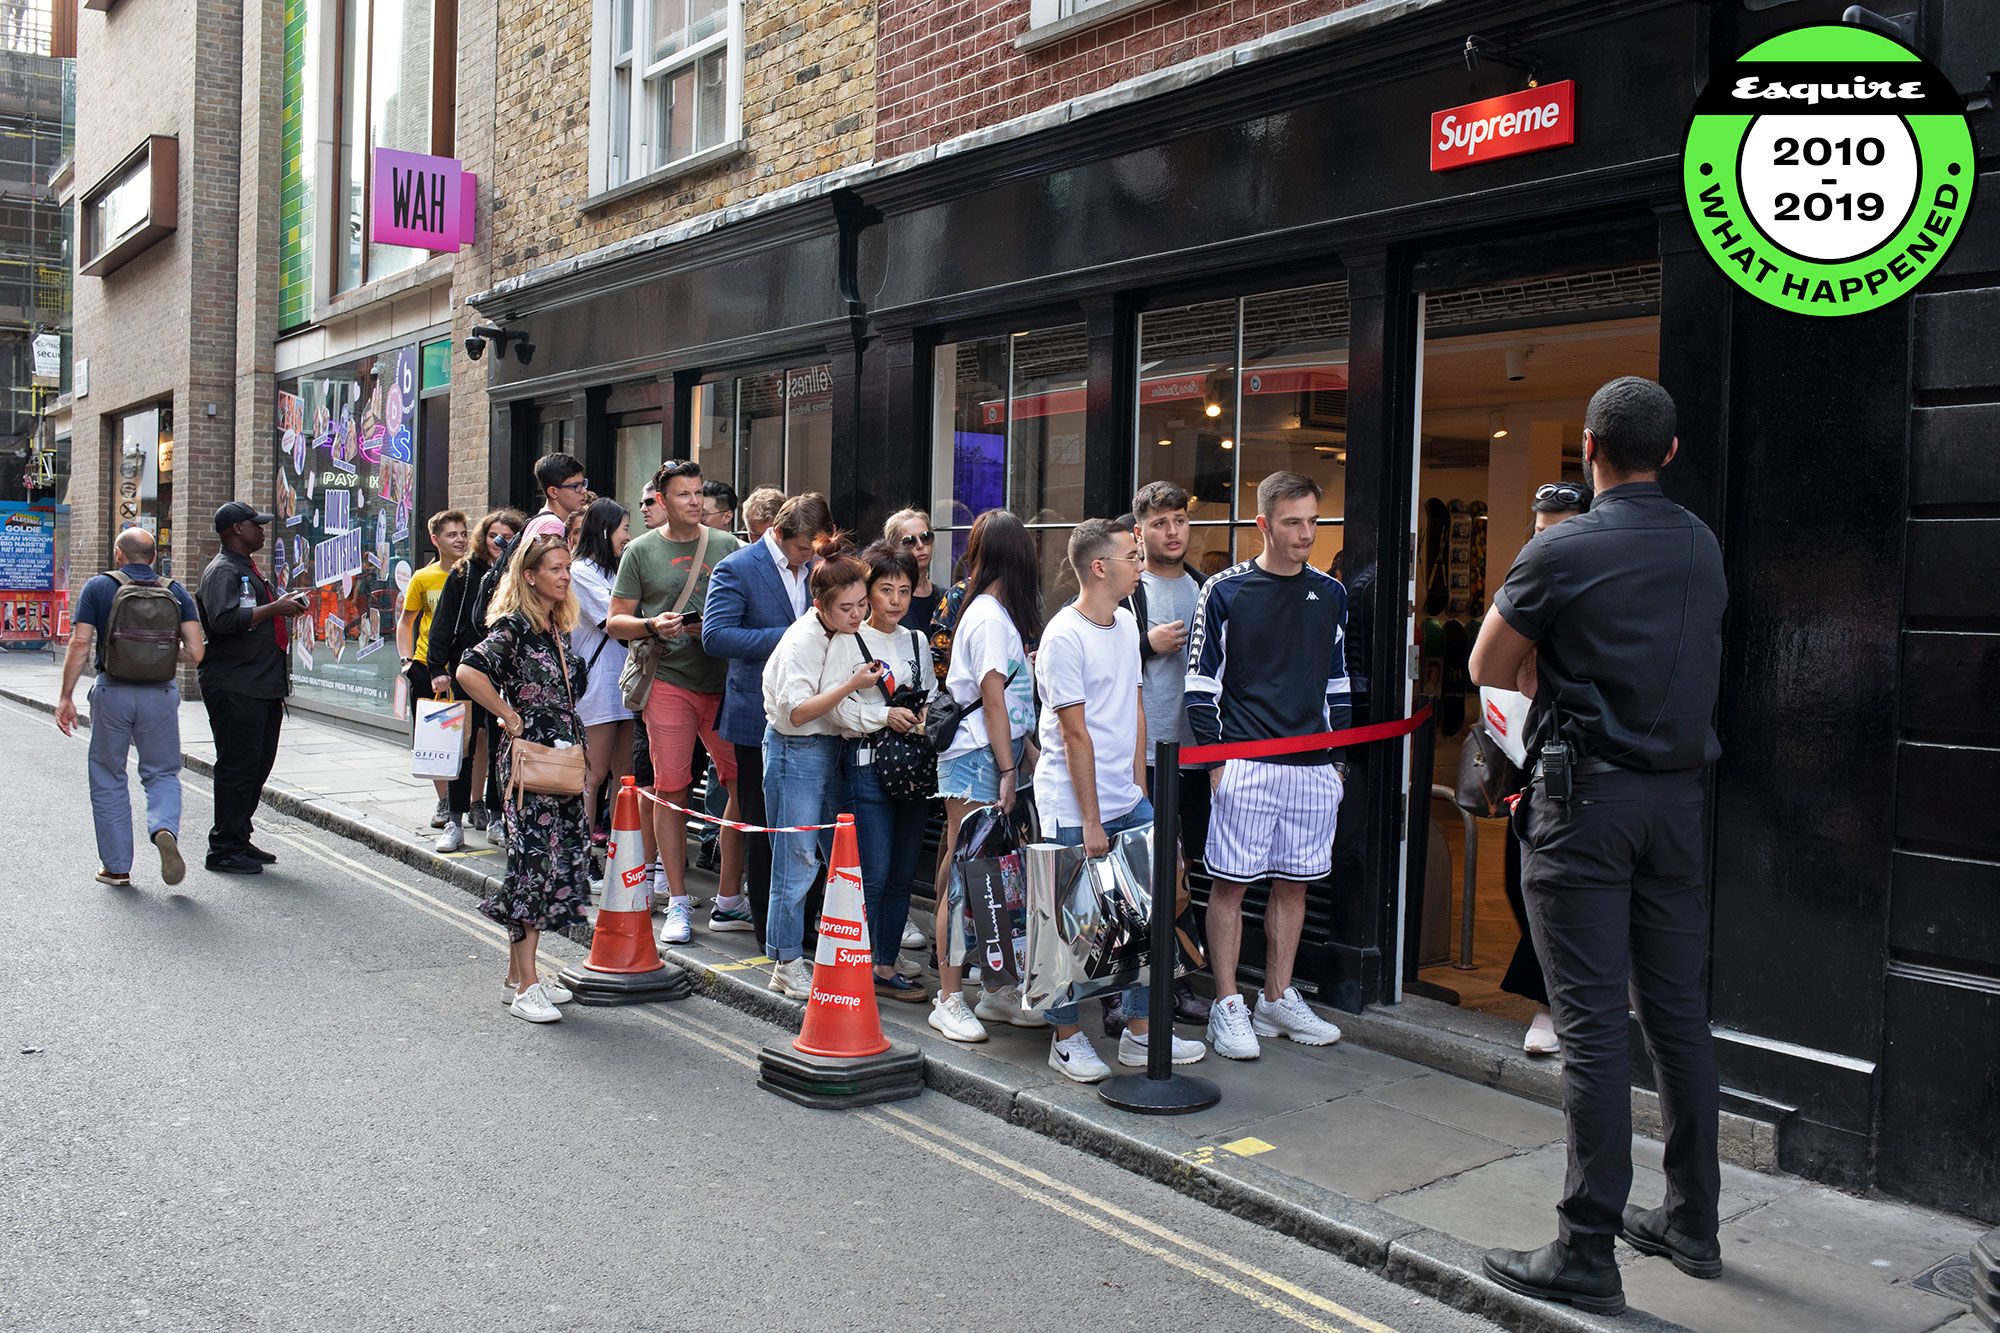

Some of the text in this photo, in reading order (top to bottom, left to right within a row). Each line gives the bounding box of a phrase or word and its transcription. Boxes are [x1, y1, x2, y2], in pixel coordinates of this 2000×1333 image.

[1438, 102, 1560, 156] Supreme
[393, 166, 446, 234] WAH
[322, 471, 359, 488] PAY
[5, 525, 42, 533] GOLDIE
[415, 750, 451, 760] OFFICE
[983, 873, 1004, 972] Champion
[812, 986, 861, 1006] Supreme
